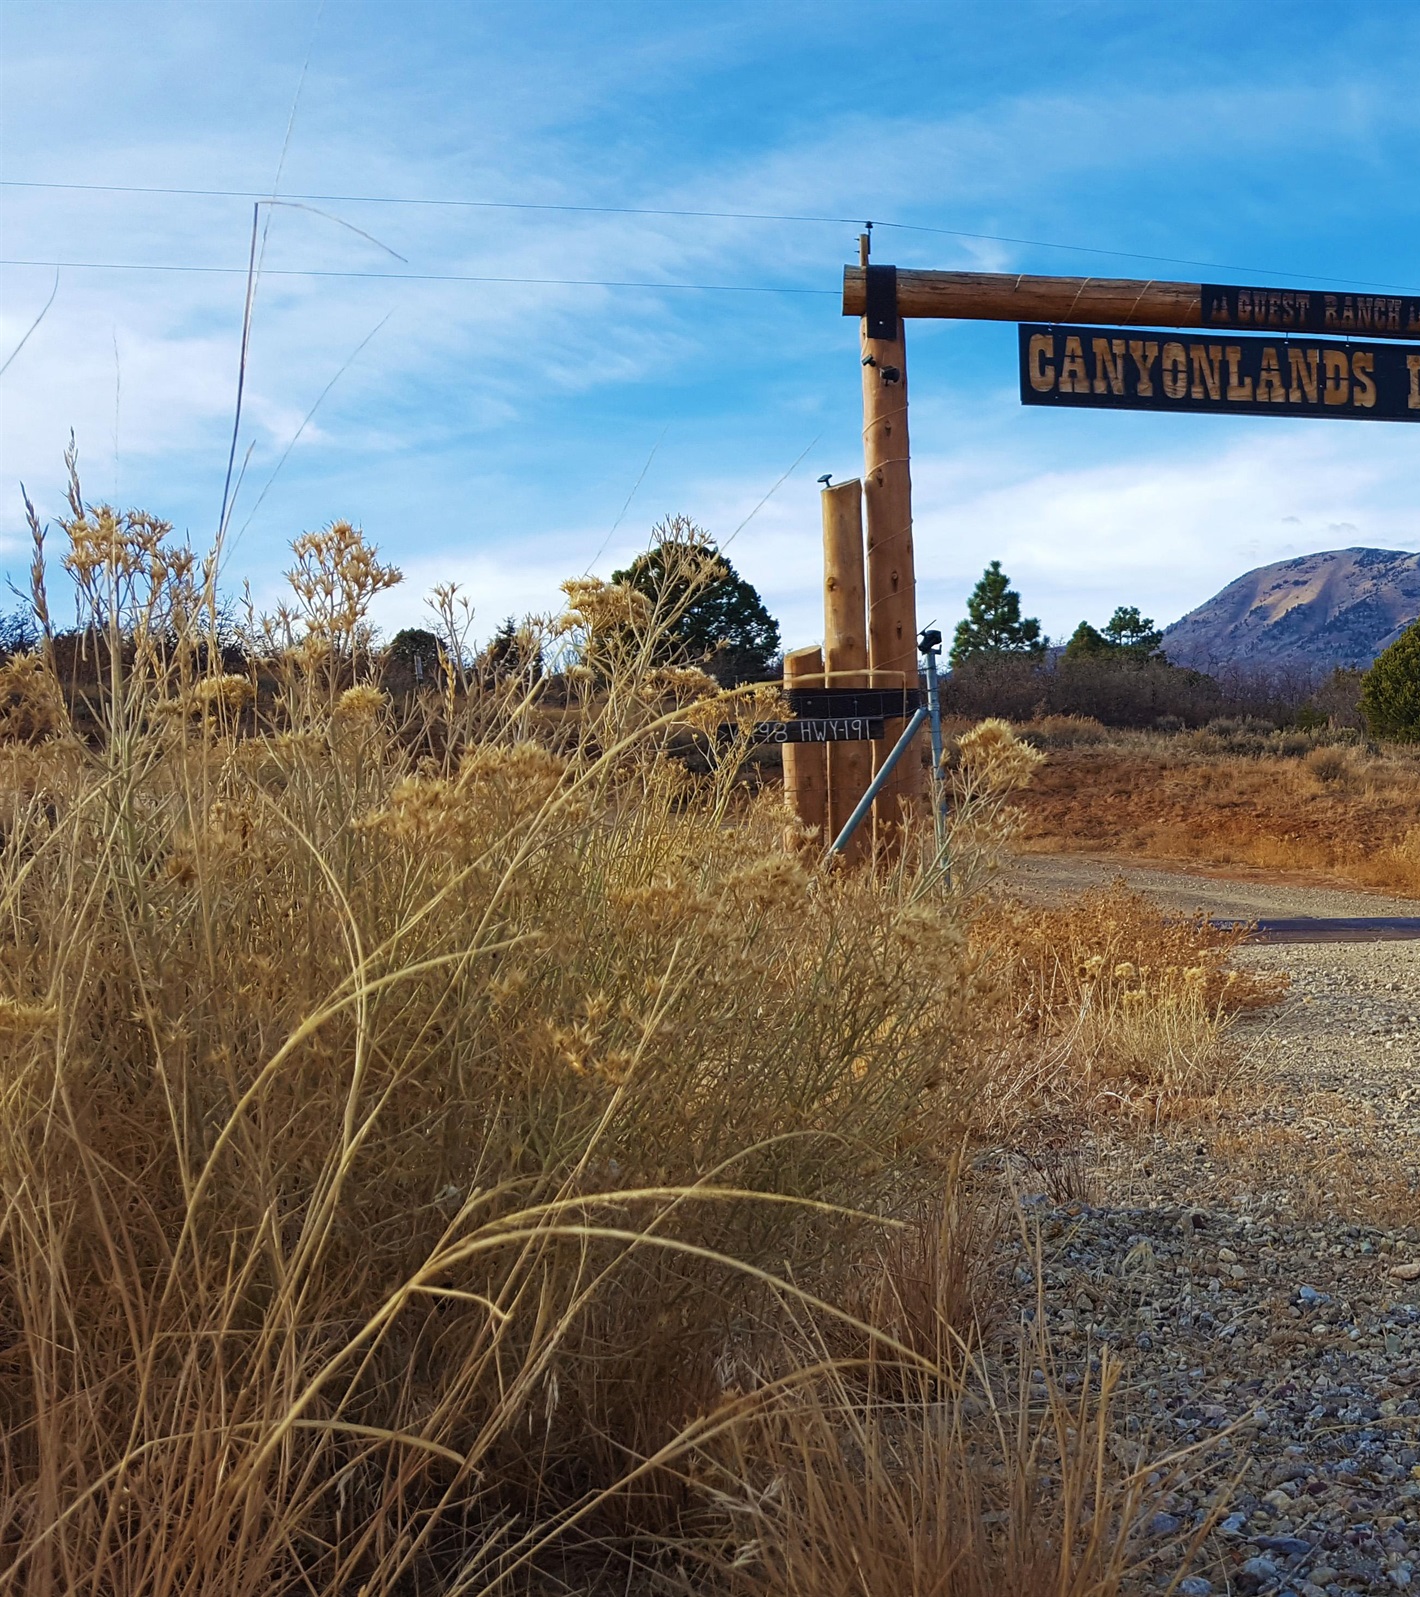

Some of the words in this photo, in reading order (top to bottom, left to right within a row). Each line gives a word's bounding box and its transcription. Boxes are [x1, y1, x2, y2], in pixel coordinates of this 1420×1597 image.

[1237, 290, 1311, 327] GUEST
[1323, 295, 1402, 331] RANCH
[1028, 332, 1376, 408] CANYONLANDS
[800, 719, 870, 742] HWY-191
